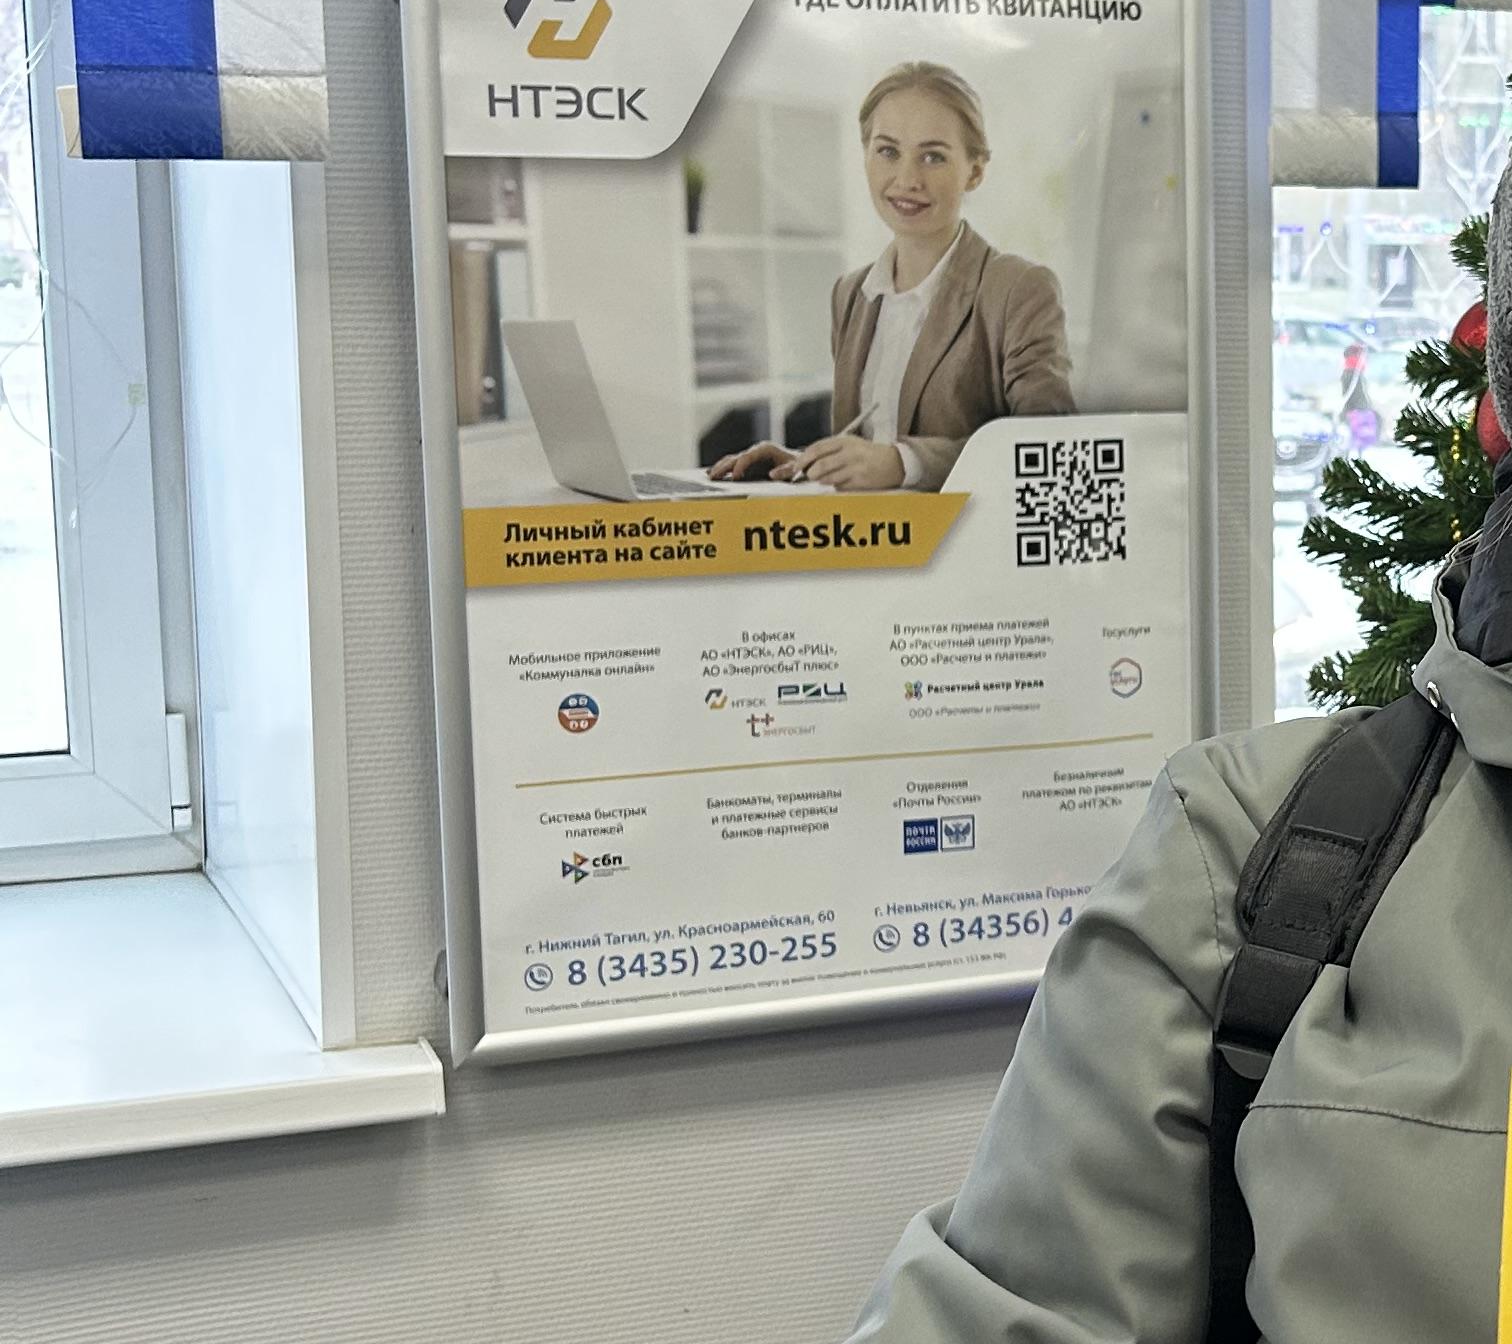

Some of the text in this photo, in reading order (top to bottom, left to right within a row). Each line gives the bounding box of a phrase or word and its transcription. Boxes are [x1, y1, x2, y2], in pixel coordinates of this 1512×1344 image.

[487, 83, 649, 122] НТЭСК
[505, 517, 715, 543] Личный кабинет
[744, 514, 911, 552] ntesk.ru
[506, 540, 718, 569] клиента на сайте
[742, 631, 795, 643] В офисах
[893, 623, 901, 636] В
[701, 649, 718, 661] АО
[778, 645, 795, 656] АО
[889, 638, 907, 652] АО
[509, 645, 661, 666] Мобильное приложение
[900, 654, 929, 668] ООО
[519, 666, 602, 682] «Коммуналка
[703, 666, 719, 677] АО
[983, 679, 1013, 693] центр
[1014, 678, 1044, 691] Урала
[706, 795, 774, 811] Банкоматы,
[1059, 799, 1076, 811] АО
[539, 809, 591, 826] Система
[711, 814, 720, 825] и
[565, 823, 624, 840] платежей
[592, 853, 623, 868] сбп
[886, 890, 1043, 916] Невьянск, ул. Максима
[538, 933, 601, 953] Нижний
[604, 930, 650, 947] Тагил,
[654, 927, 675, 943] ул.
[678, 914, 815, 939] Красноармейская,
[817, 909, 835, 923] 60
[913, 908, 1050, 948] 8 (34356)
[568, 959, 588, 986] 8
[597, 945, 700, 987] (3435)
[709, 931, 837, 970] 230-255
